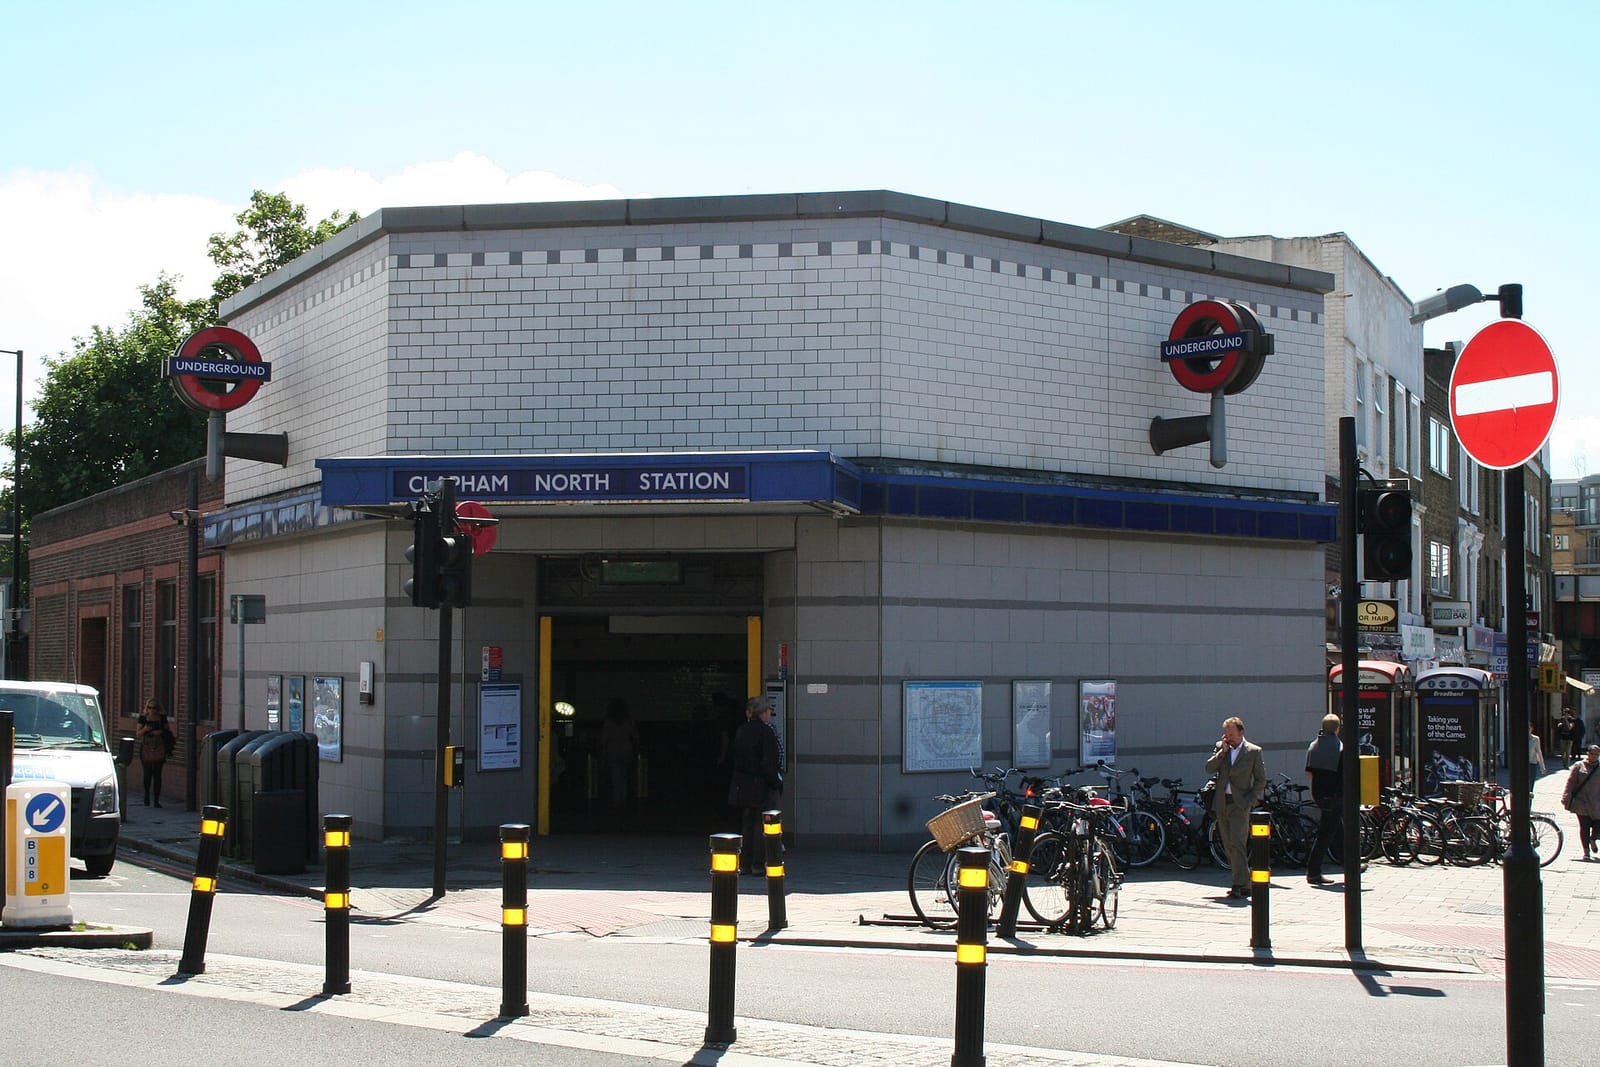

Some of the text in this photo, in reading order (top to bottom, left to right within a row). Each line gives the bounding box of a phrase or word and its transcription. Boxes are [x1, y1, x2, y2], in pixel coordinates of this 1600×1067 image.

[1165, 337, 1243, 356] UNDERGROUND
[175, 361, 265, 376] UNDERGROUND
[408, 471, 729, 493] CLPHAM NORTH STATION
[1366, 602, 1378, 615] Q
[1427, 715, 1446, 724] Taking
[1446, 731, 1466, 739] Games
